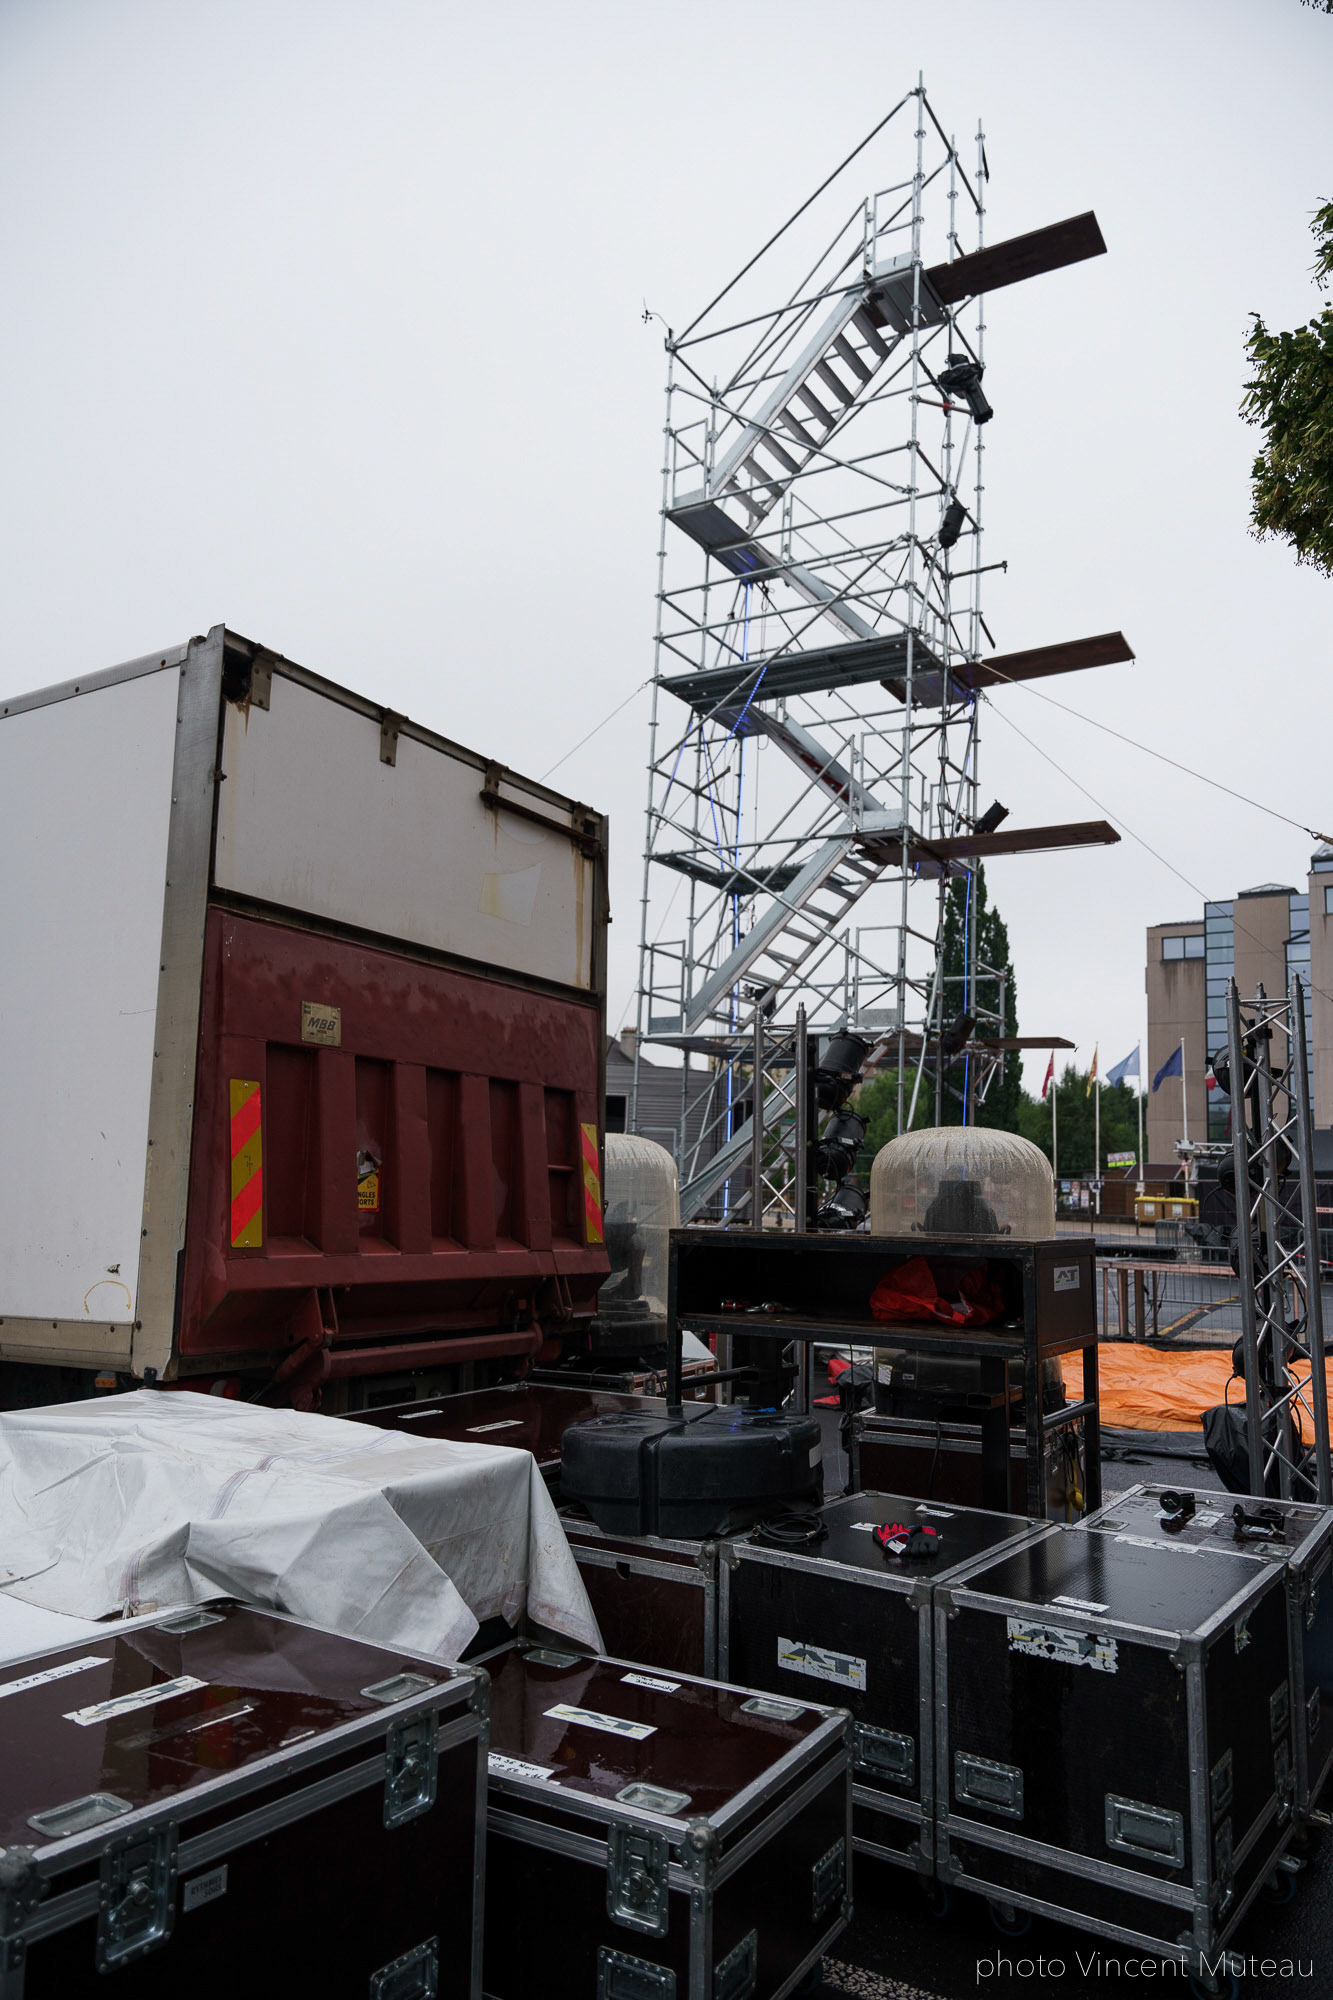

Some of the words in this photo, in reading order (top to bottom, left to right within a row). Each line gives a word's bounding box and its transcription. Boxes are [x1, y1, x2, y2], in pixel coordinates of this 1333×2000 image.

[308, 1016, 336, 1031] MBB
[781, 1648, 862, 1676] AT
[553, 1710, 650, 1731] AT
